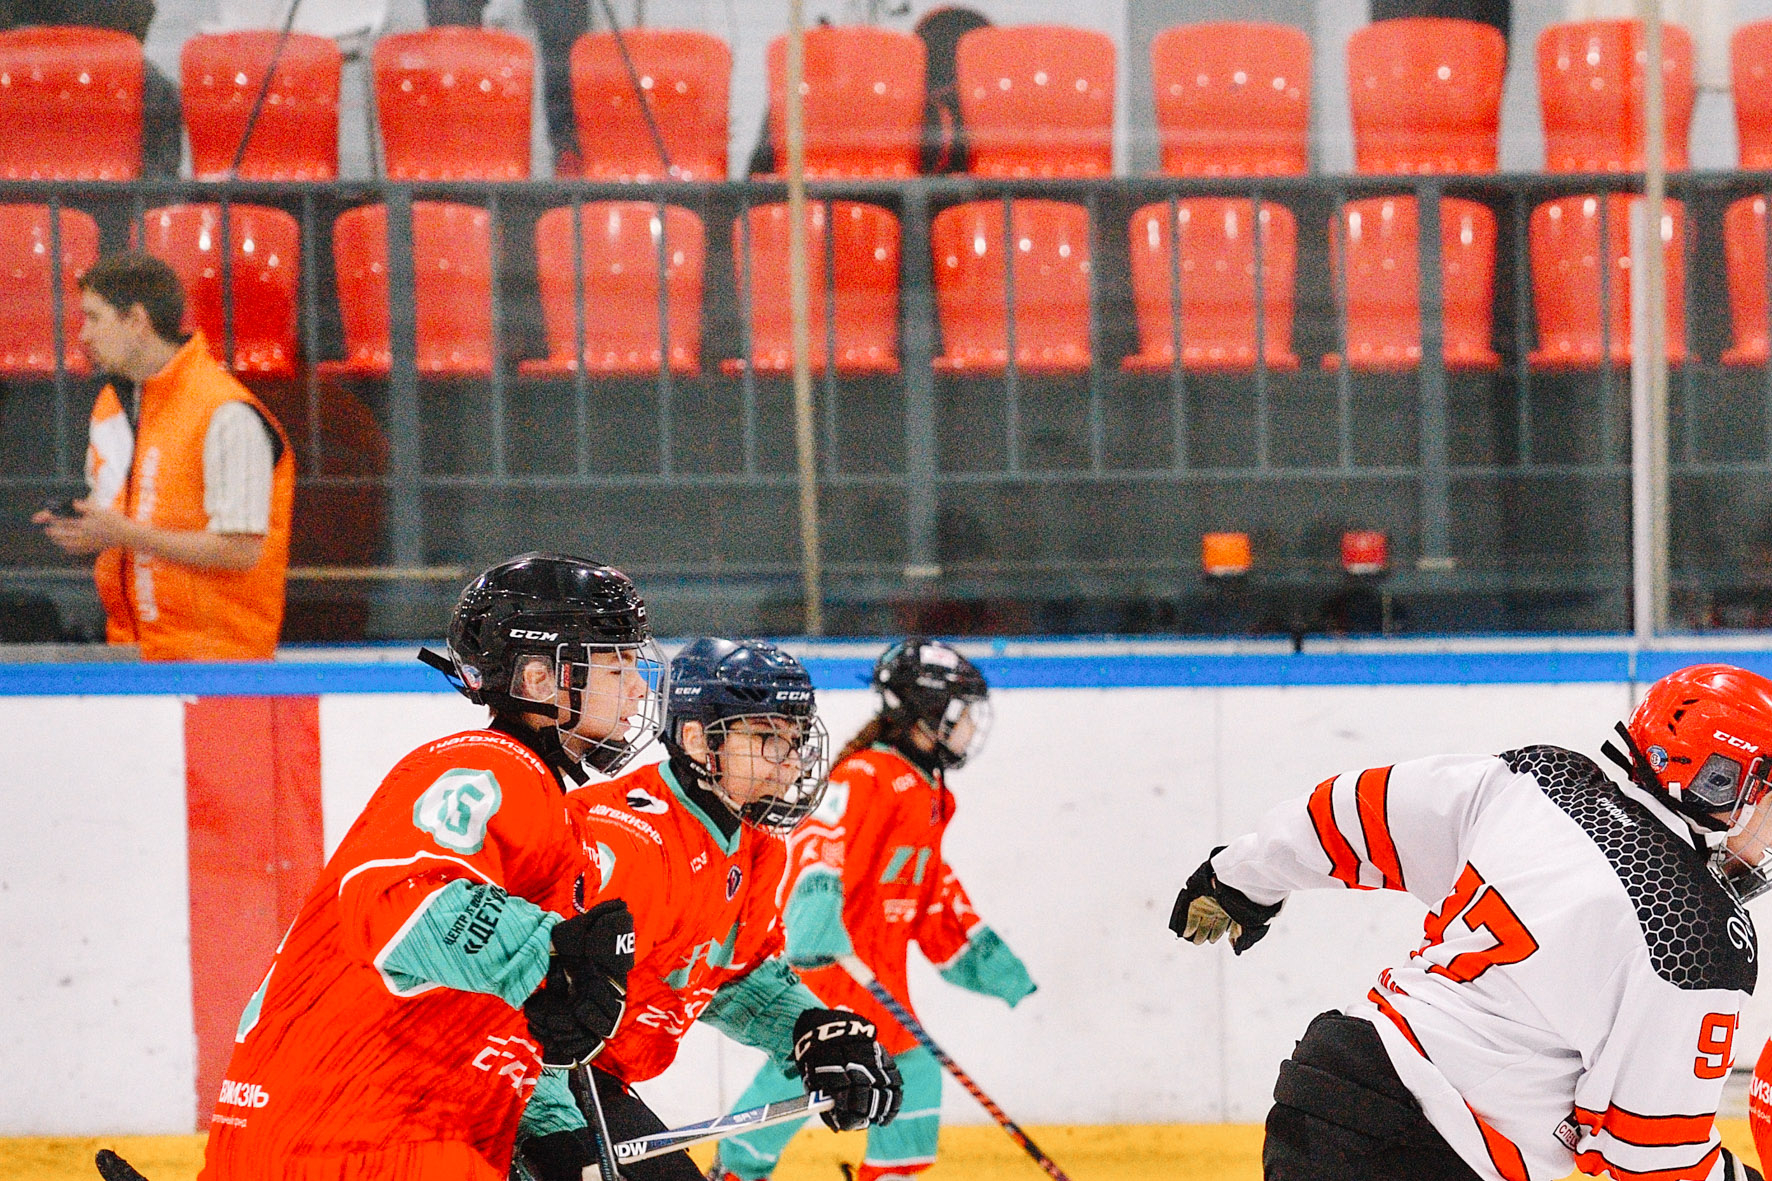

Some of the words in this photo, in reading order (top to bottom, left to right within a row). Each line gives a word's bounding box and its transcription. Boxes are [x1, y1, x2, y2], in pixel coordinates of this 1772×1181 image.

[509, 628, 559, 642] CCM
[674, 686, 701, 695] CCM
[775, 690, 810, 701] CCM
[1713, 729, 1760, 753] CCM
[794, 1019, 876, 1061] CCM
[1694, 1011, 1740, 1080] 9
